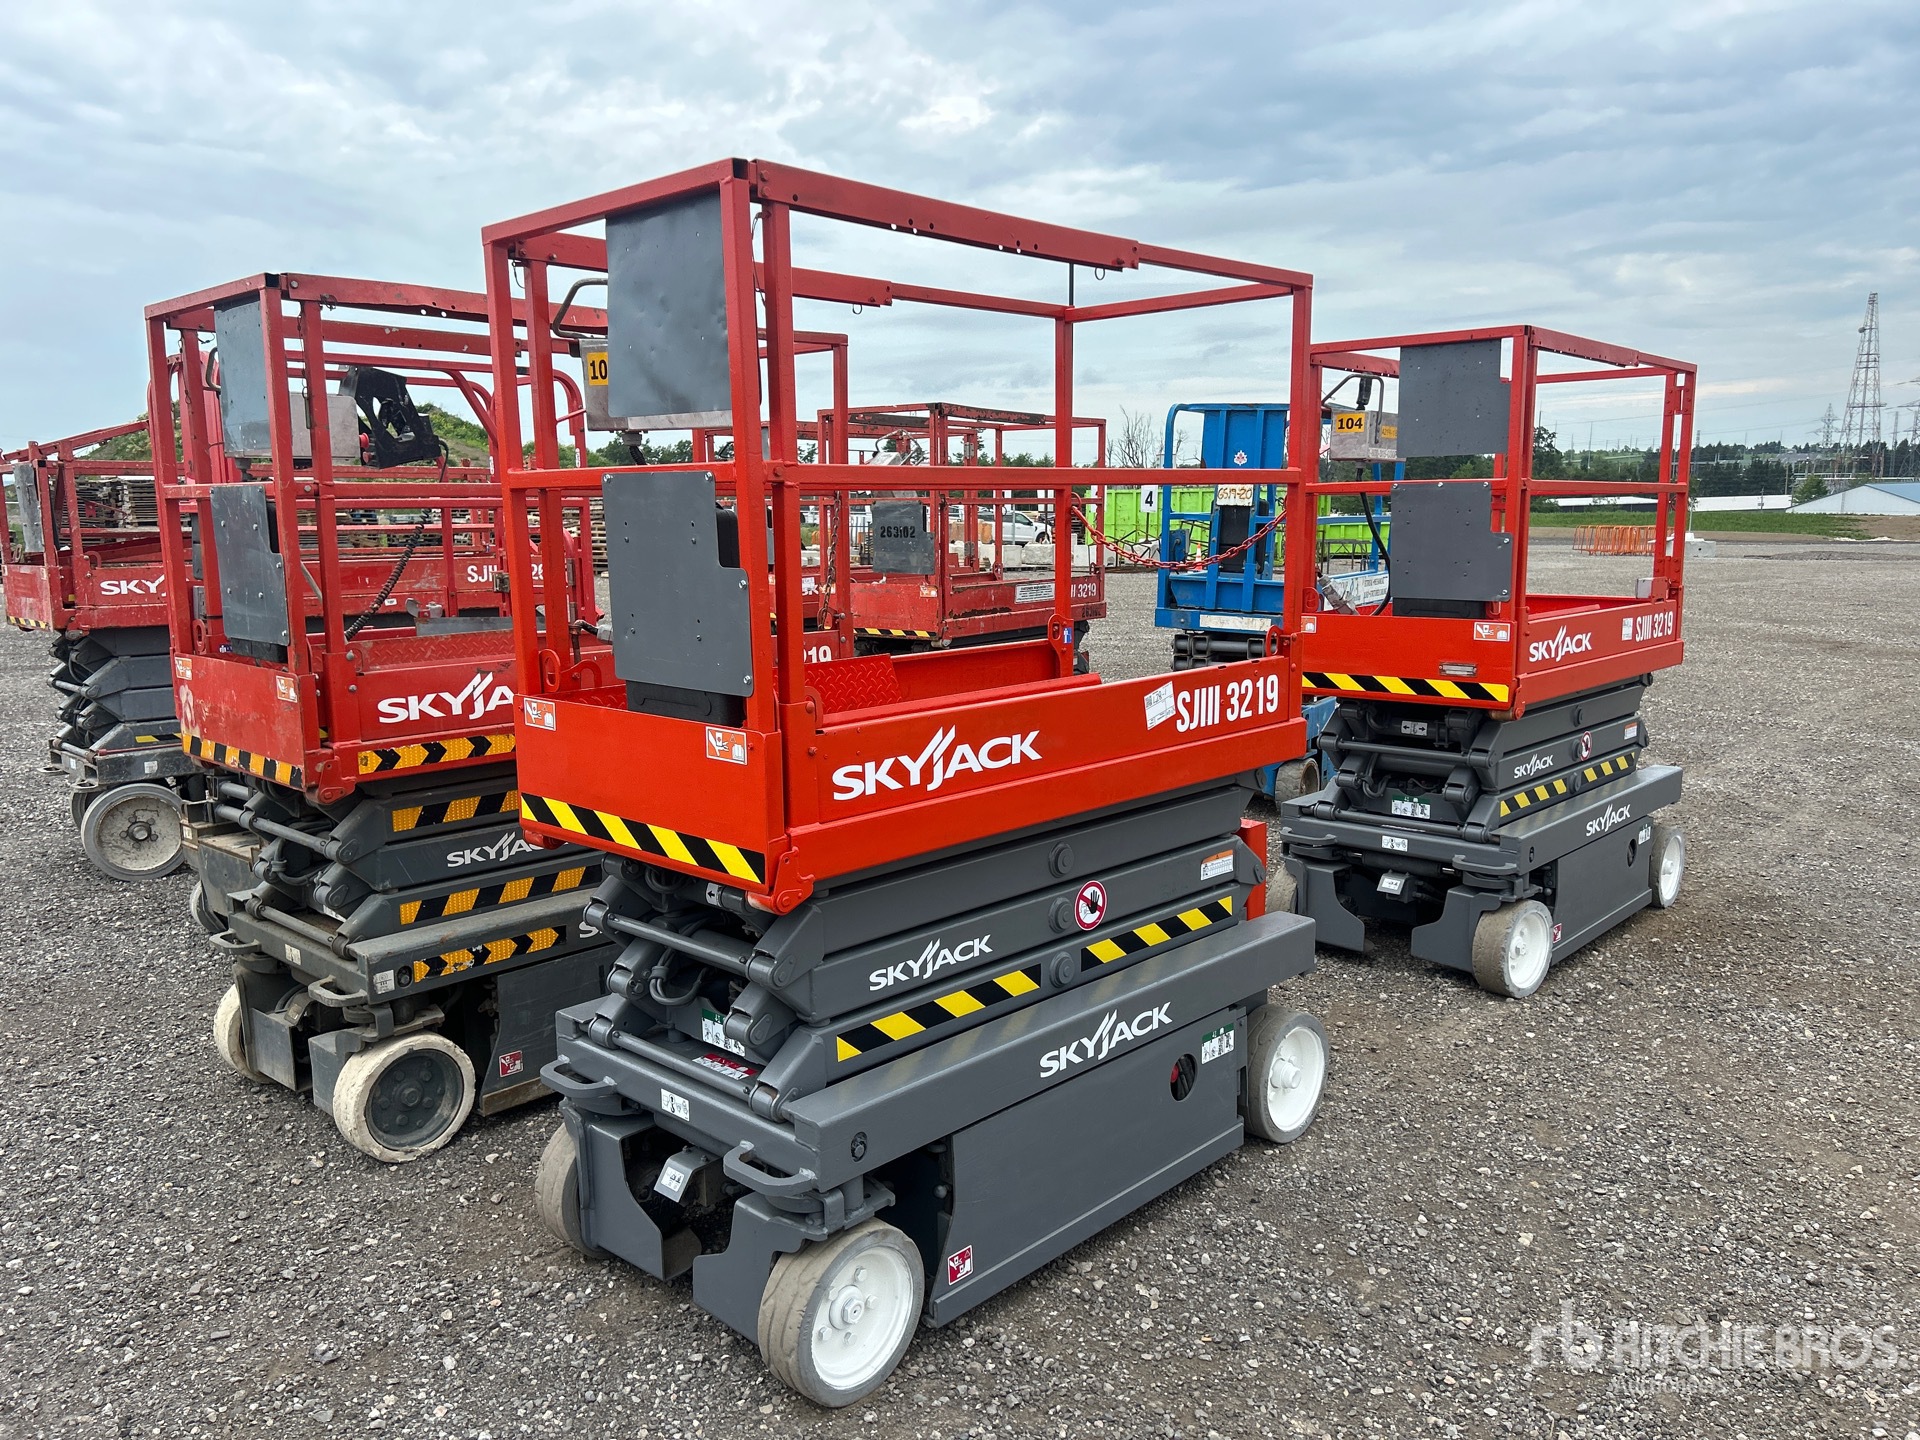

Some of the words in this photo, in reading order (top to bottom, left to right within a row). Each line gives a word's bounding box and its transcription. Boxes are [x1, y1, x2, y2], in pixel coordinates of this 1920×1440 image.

[590, 359, 608, 380] 10
[1338, 418, 1363, 430] 104
[1144, 491, 1154, 507] 4
[1077, 583, 1097, 599] 3219
[1653, 611, 1674, 637] 3219
[1529, 625, 1592, 662] SKYJACK
[377, 671, 514, 724] SKYJA
[1176, 684, 1220, 733] SJIII
[1226, 674, 1279, 722] 3219
[831, 724, 1043, 801] SKYJACK
[1513, 753, 1554, 779] SKYJACK
[1585, 804, 1631, 837] SKYJACK
[446, 831, 545, 868] SKYJA
[869, 934, 993, 991] SKYJACK
[1039, 1001, 1173, 1079] SKYJACK
